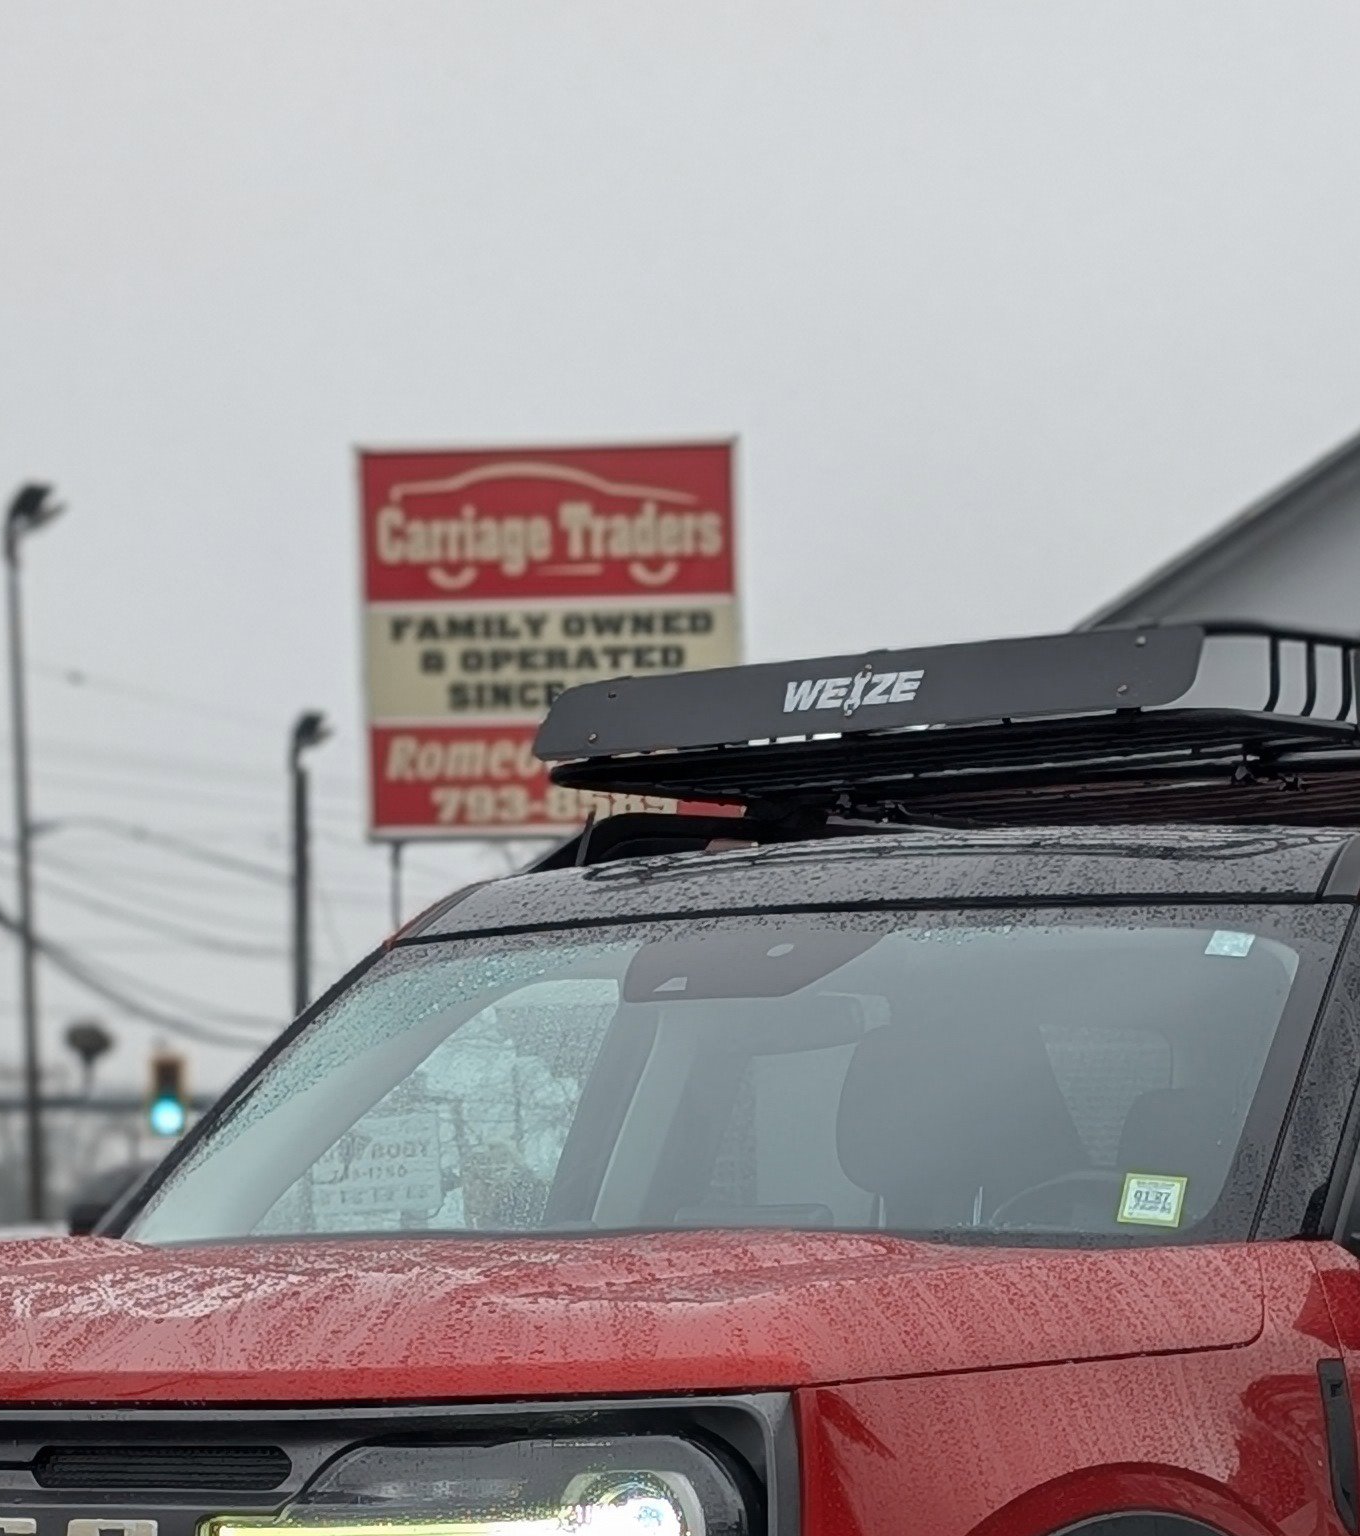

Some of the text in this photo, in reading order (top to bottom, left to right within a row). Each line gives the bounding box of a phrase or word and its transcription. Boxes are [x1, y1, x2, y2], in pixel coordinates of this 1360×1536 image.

[377, 501, 723, 576] Carriage Traders
[390, 609, 714, 642] FAMILY OWNED
[460, 645, 686, 672] OPERATED
[448, 681, 564, 711] SINCE
[783, 664, 925, 716] WEIZE
